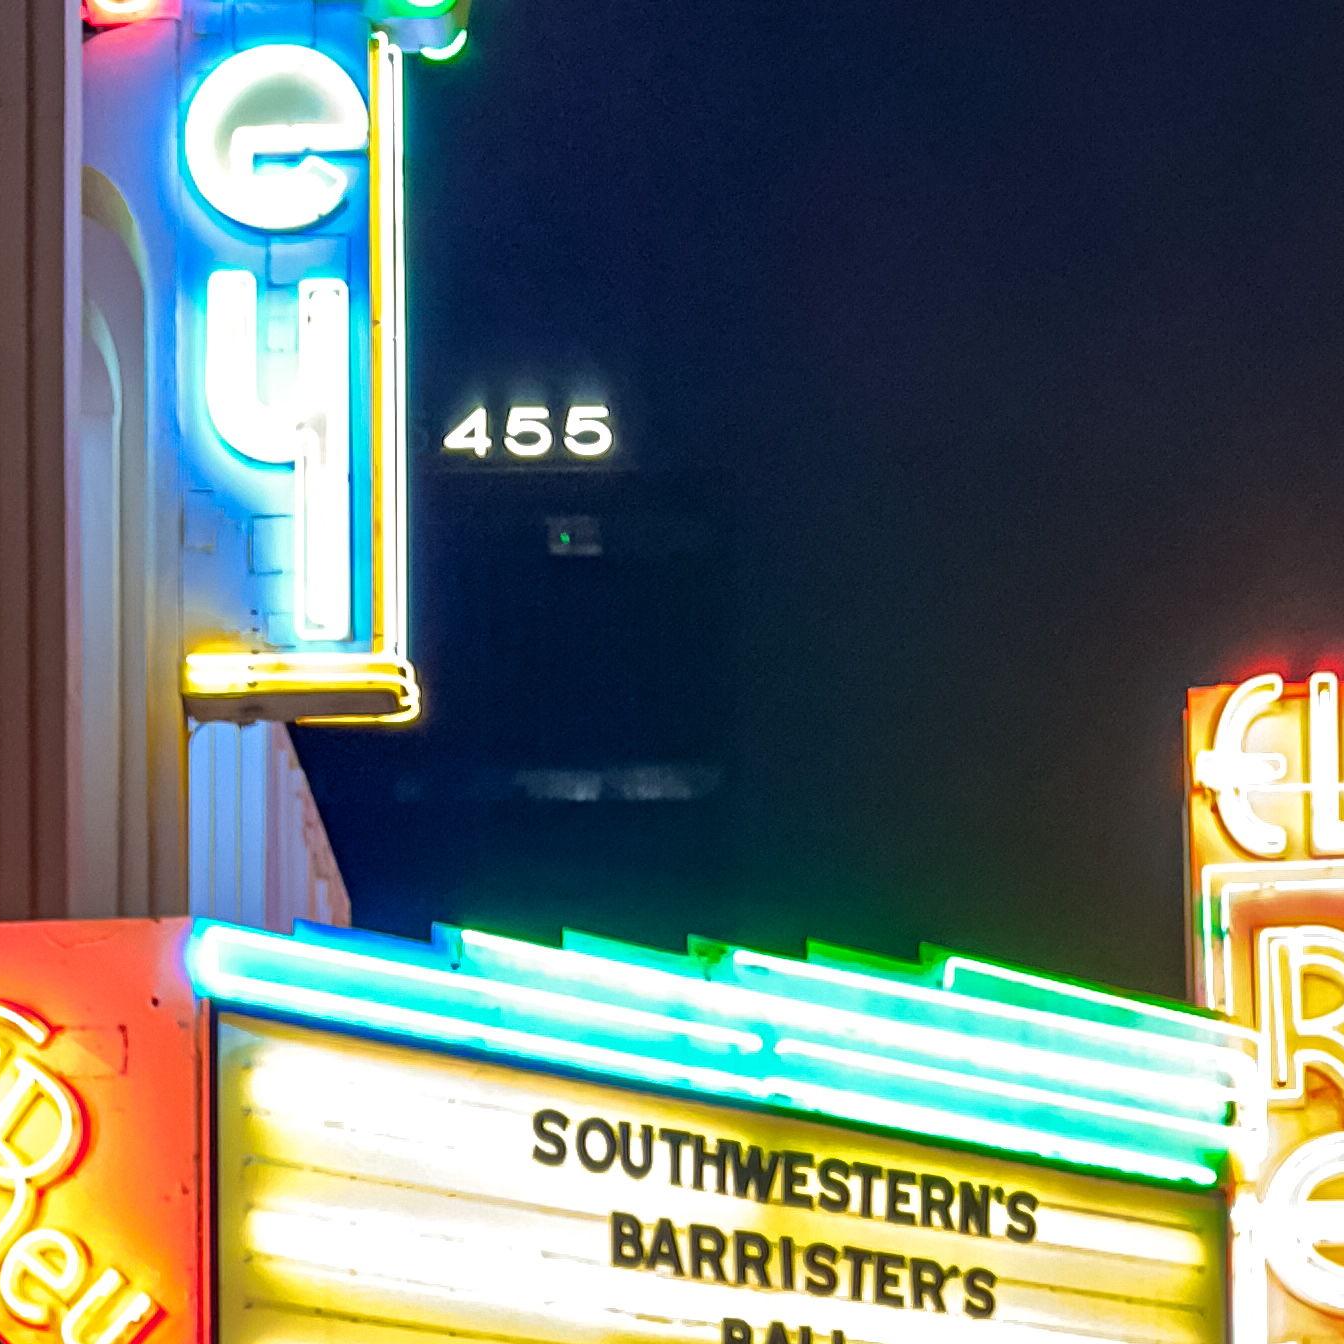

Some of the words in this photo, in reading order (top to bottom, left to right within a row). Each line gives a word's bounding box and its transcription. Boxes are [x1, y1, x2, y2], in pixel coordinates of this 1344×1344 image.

[442, 404, 614, 459] 455
[531, 1108, 1040, 1244] SOUTHWESTERN'S
[610, 1211, 998, 1318] BARRISTER'S
